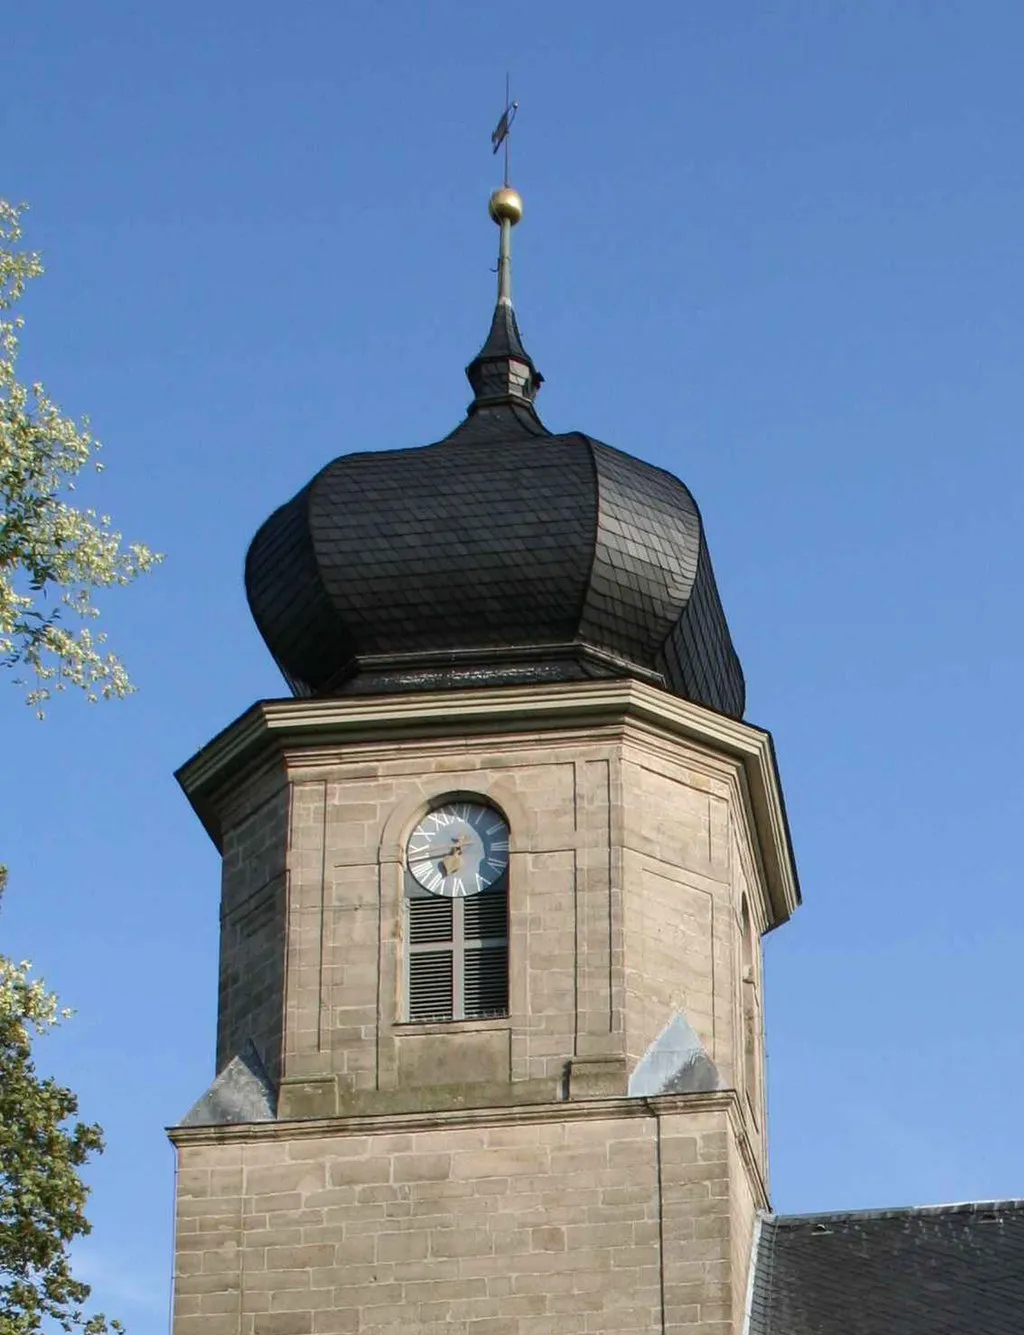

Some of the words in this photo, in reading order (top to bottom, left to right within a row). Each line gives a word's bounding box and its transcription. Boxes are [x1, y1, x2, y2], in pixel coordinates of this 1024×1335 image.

[428, 808, 450, 831] XI
[413, 825, 436, 842] X
[408, 844, 430, 862] IX
[475, 872, 492, 892] V
